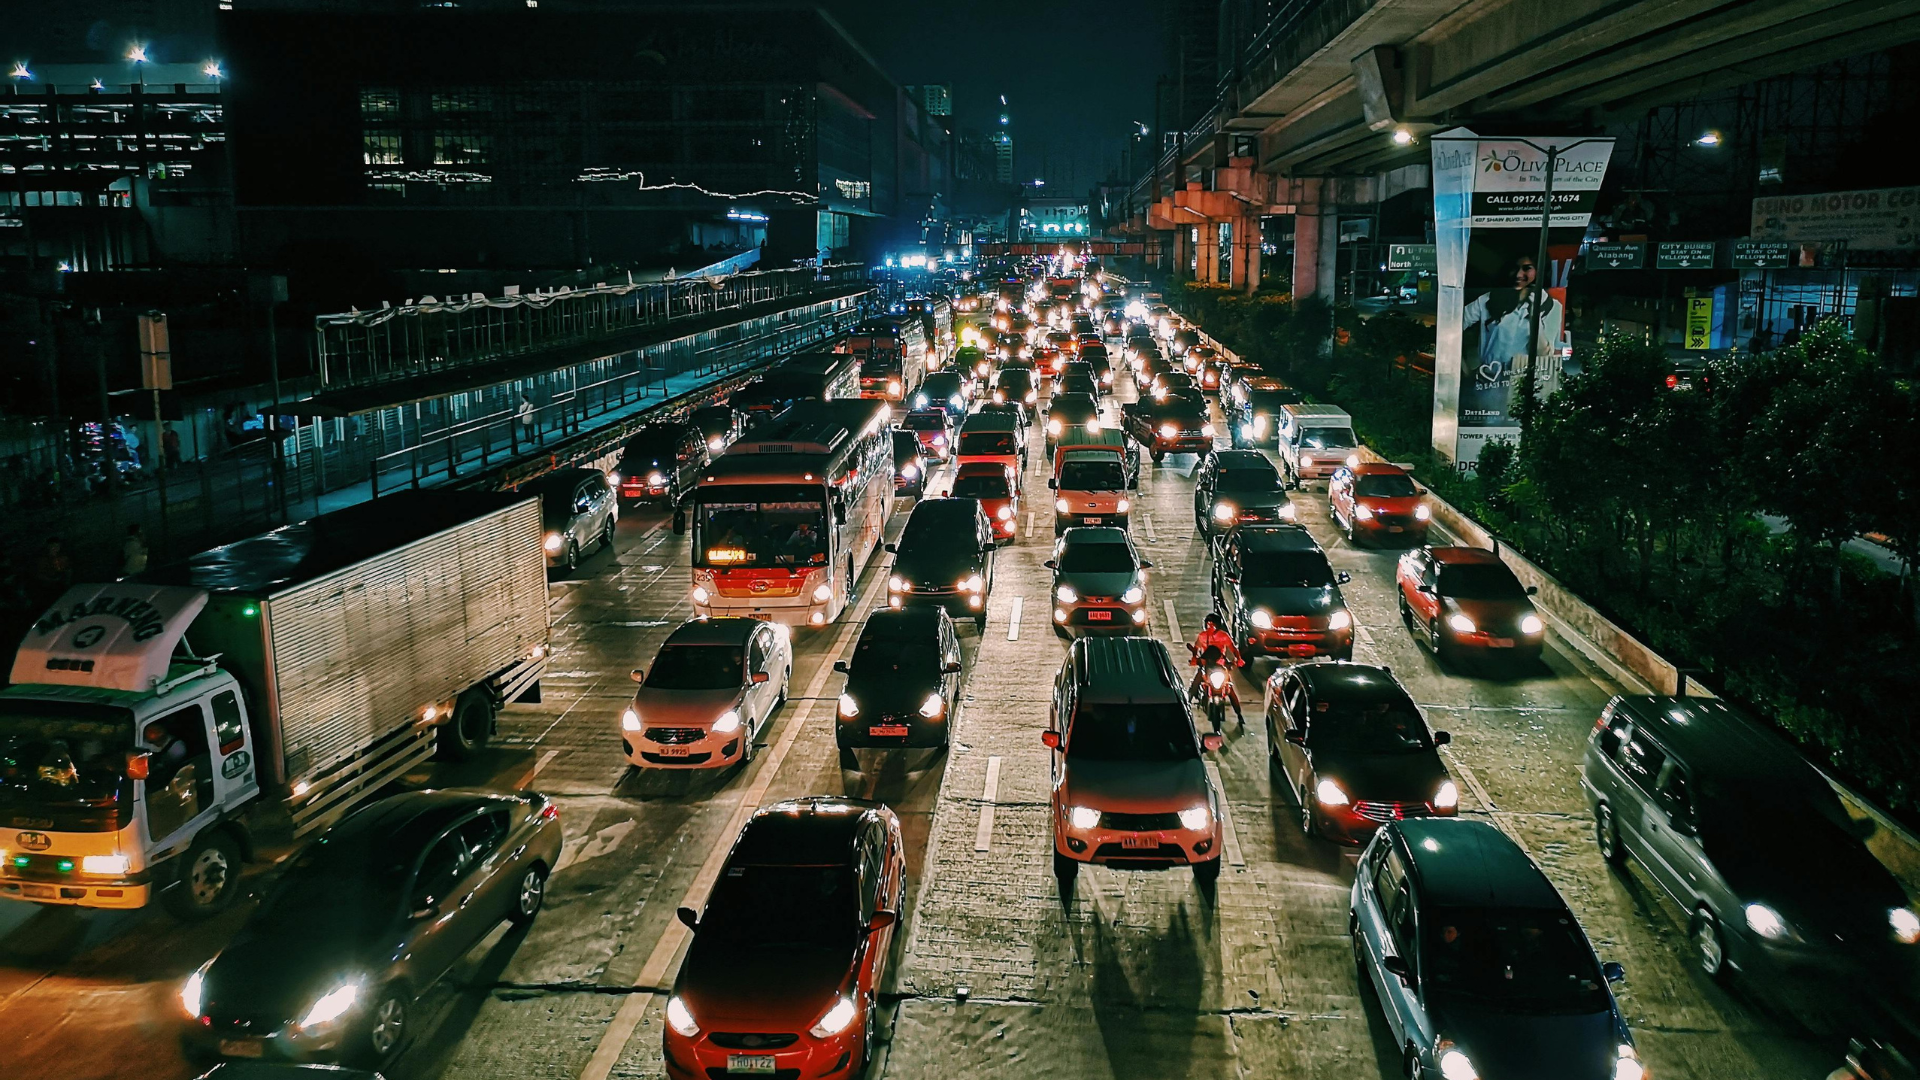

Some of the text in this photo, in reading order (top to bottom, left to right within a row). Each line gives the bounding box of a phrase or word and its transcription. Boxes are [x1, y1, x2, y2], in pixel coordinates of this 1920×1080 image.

[1503, 155, 1549, 172] OLIV
[1486, 195, 1510, 204] CALL
[1756, 197, 1804, 214] SEINO
[1810, 193, 1879, 212] MOTOR
[1596, 252, 1634, 261] Alabang
